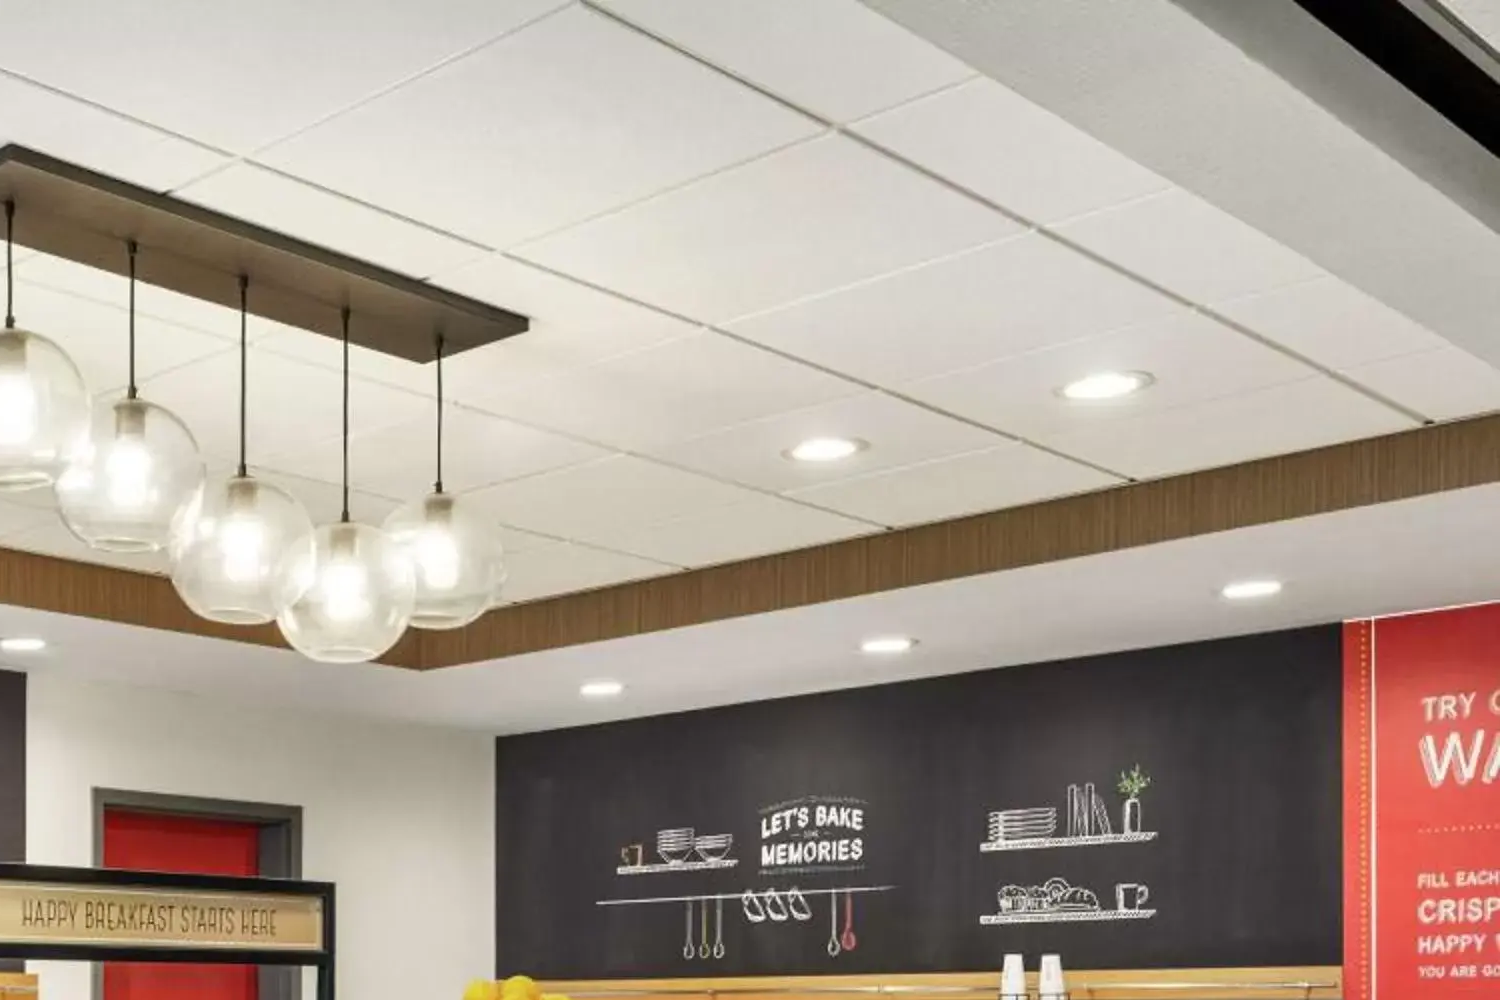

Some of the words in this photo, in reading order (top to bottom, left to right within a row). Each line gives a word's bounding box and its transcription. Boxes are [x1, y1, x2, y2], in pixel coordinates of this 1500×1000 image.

[1421, 691, 1476, 722] TRY
[761, 806, 809, 839] LET'S
[816, 805, 864, 831] BAKE
[761, 838, 864, 866] MEMORIES
[1417, 872, 1449, 889] FILL
[21, 898, 79, 931] HAPPY
[85, 900, 175, 932] BREAKFAST
[181, 904, 235, 935] STARTS
[241, 908, 277, 936] HERE
[1417, 934, 1487, 955] HAPPY
[1417, 965, 1446, 979] YOU
[1449, 964, 1477, 978] ARE
